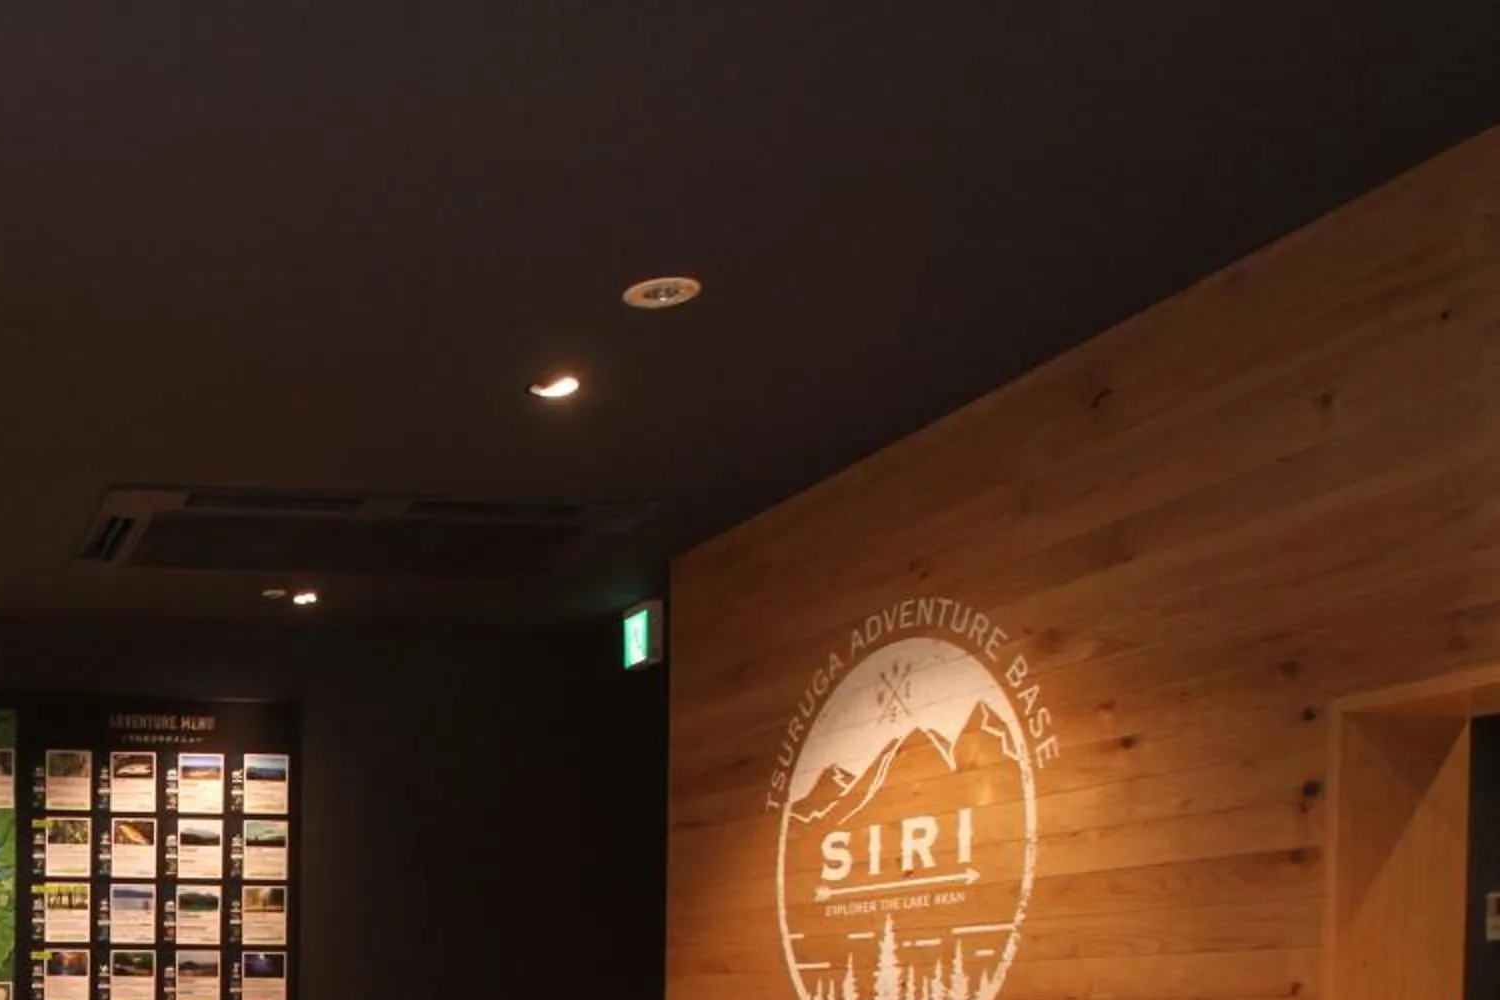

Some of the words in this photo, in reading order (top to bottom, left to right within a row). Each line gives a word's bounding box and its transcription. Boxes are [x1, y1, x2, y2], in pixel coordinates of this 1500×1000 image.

[108, 713, 180, 730] ADVENTURE
[765, 652, 845, 812] TSURUGA
[851, 597, 1009, 662] ADVENTURE
[1005, 654, 1061, 769] BASE
[821, 807, 973, 881] SIRI
[880, 897, 901, 912] THE
[902, 895, 931, 909] LAKE
